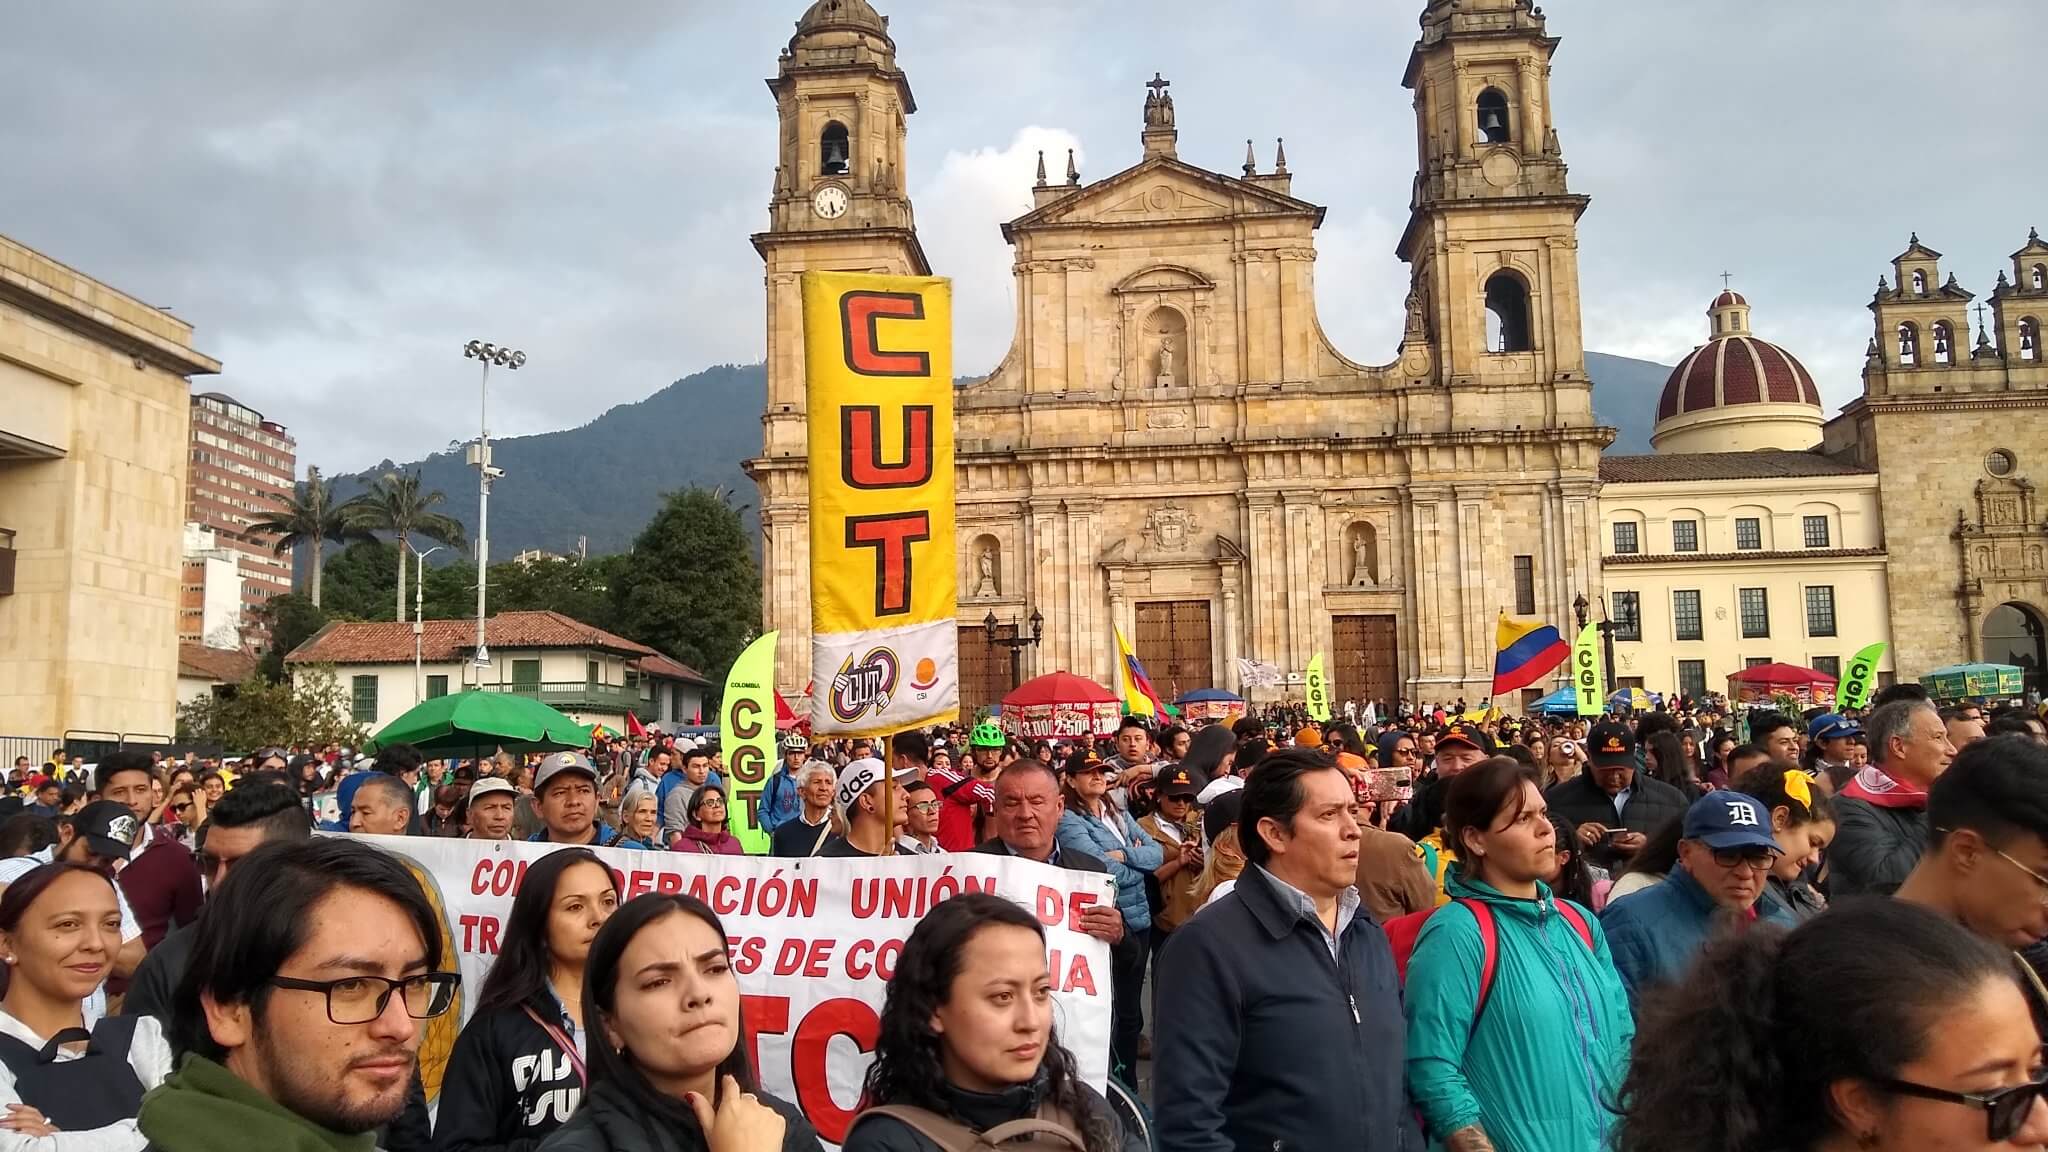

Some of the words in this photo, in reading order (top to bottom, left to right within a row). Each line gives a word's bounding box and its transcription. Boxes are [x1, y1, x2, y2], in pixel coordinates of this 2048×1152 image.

[839, 290, 934, 617] CUT
[1309, 674, 1323, 715] CGT
[1578, 650, 1596, 705] CGT
[1844, 663, 1869, 708] CGT
[731, 698, 766, 830] CGT
[839, 769, 874, 804] das
[1725, 801, 1759, 826] D
[1036, 884, 1098, 933] DE
[773, 939, 836, 978] DE
